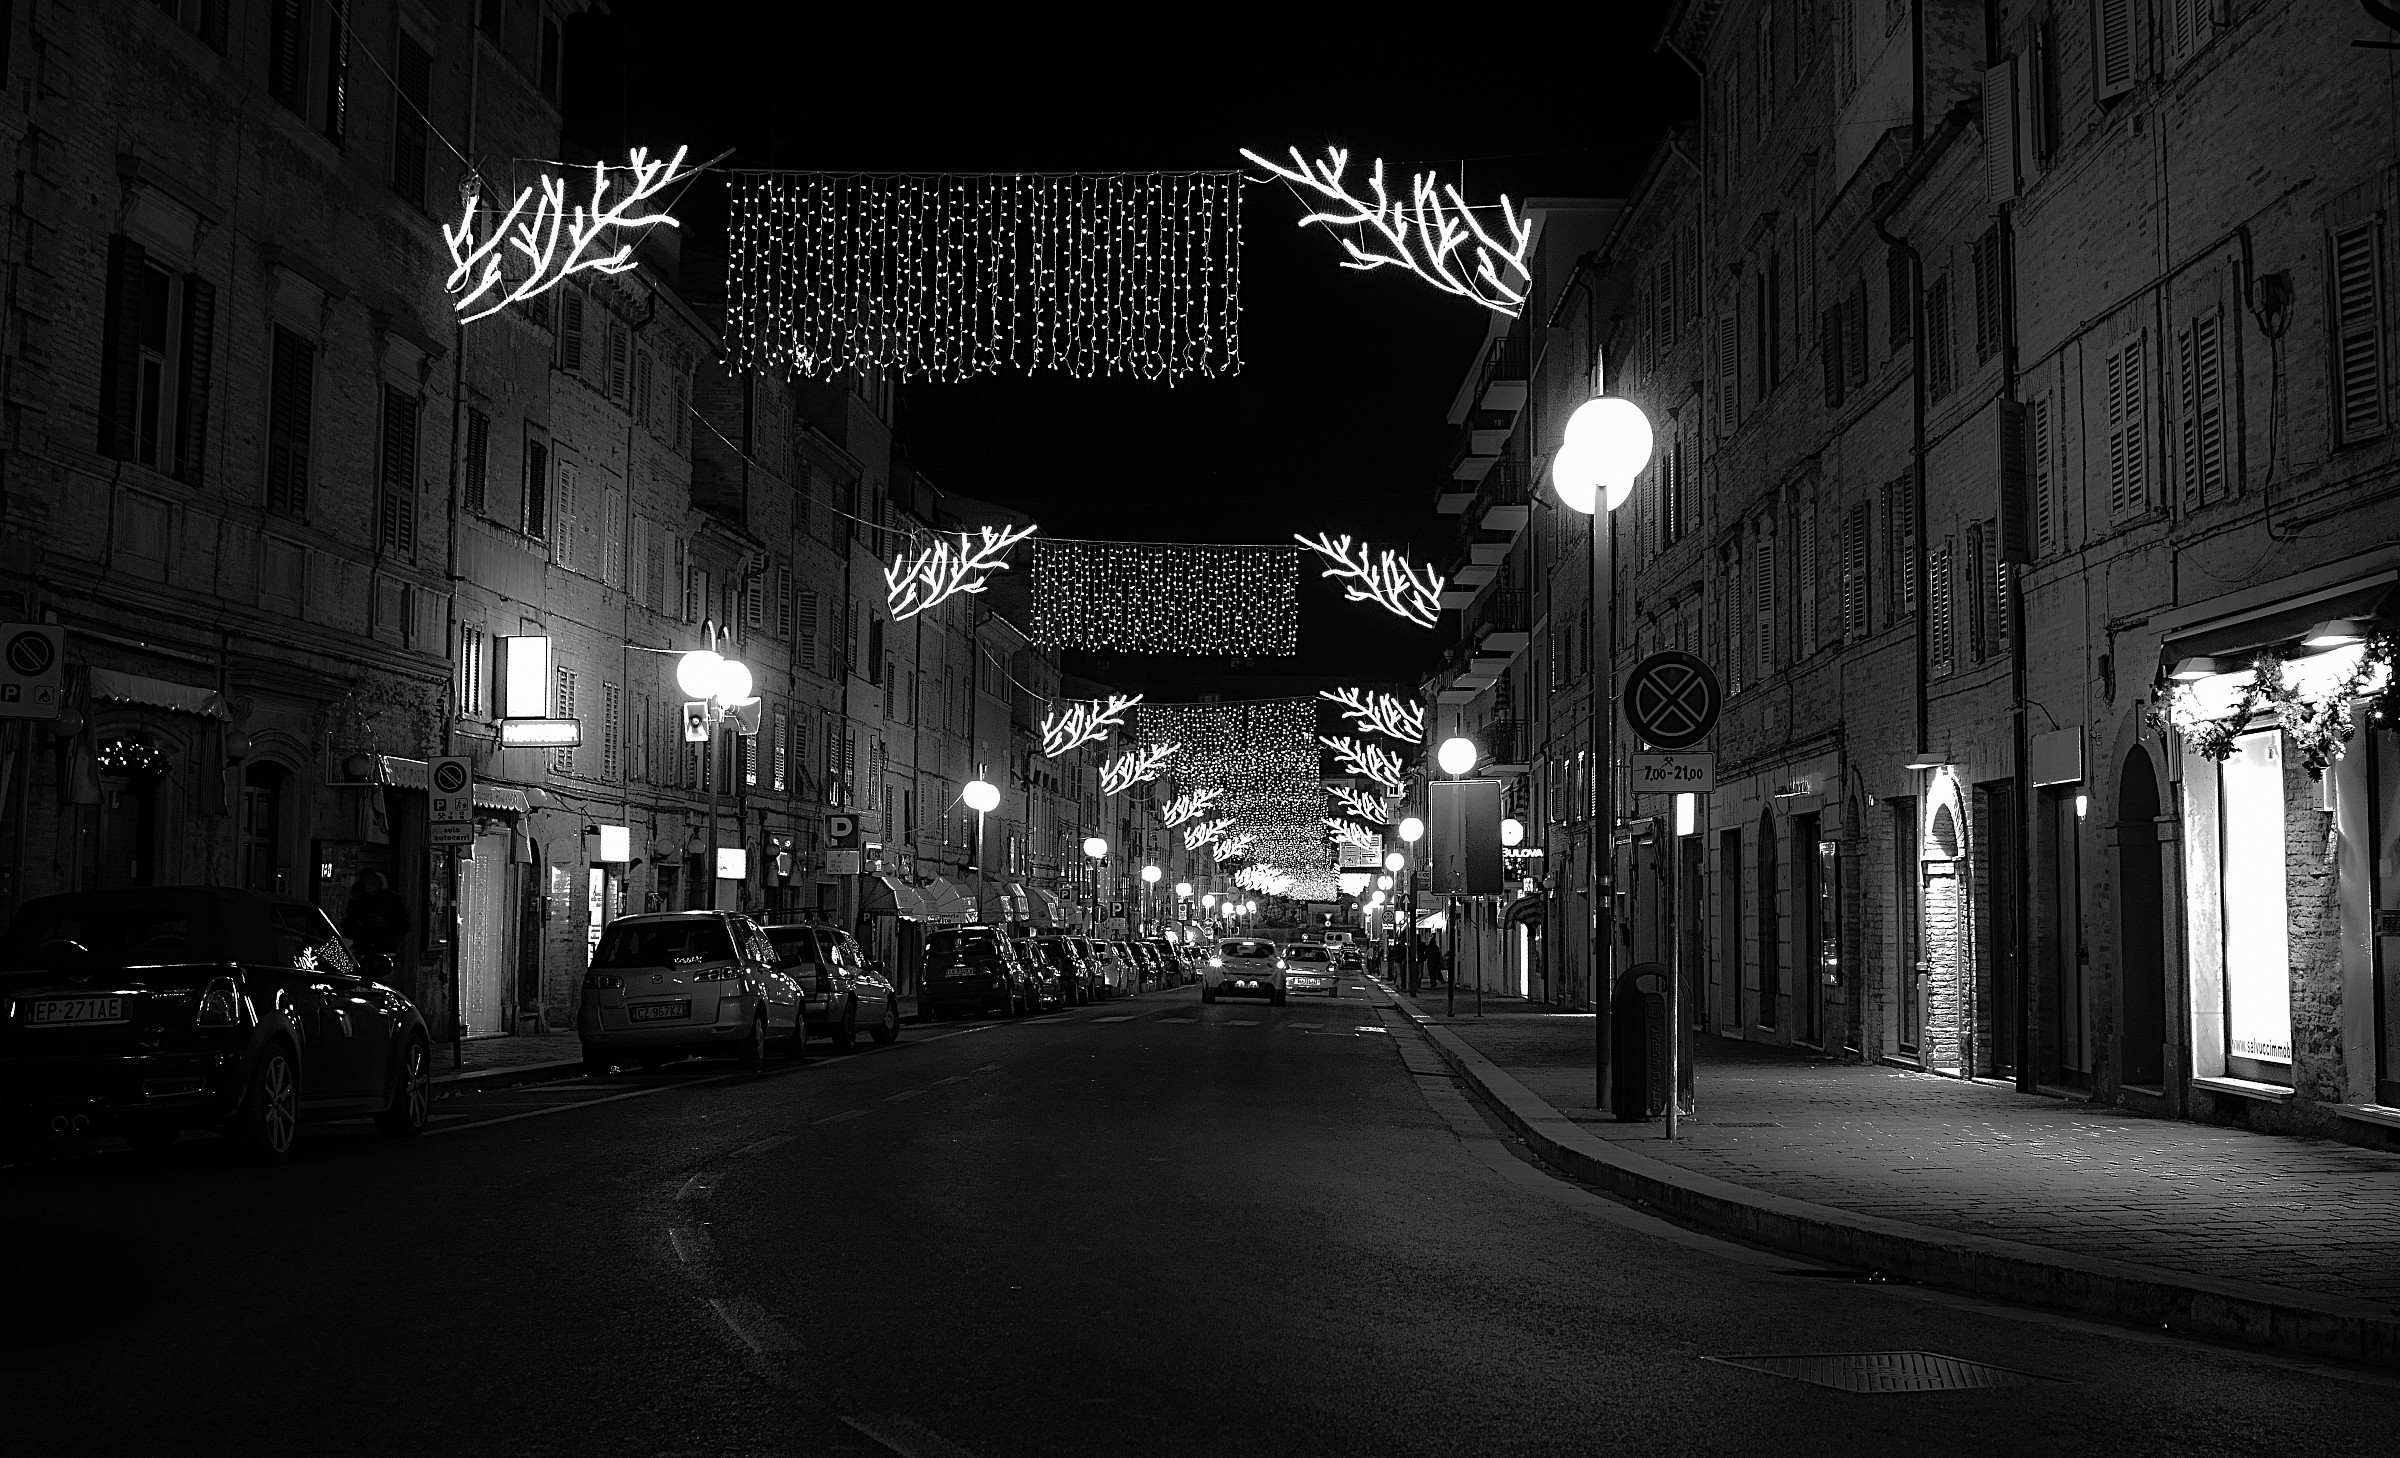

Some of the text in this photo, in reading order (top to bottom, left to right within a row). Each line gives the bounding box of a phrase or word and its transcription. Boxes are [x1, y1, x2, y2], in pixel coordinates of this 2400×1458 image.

[4, 685, 18, 701] P
[436, 800, 445, 810] P
[830, 817, 853, 846] P
[1502, 848, 1544, 858] BULOVA
[1061, 890, 1069, 899] P
[1112, 902, 1123, 917] P
[36, 999, 119, 1021] EP 271AE
[637, 1007, 649, 1018] CZ
[653, 1005, 682, 1017] 967KZ
